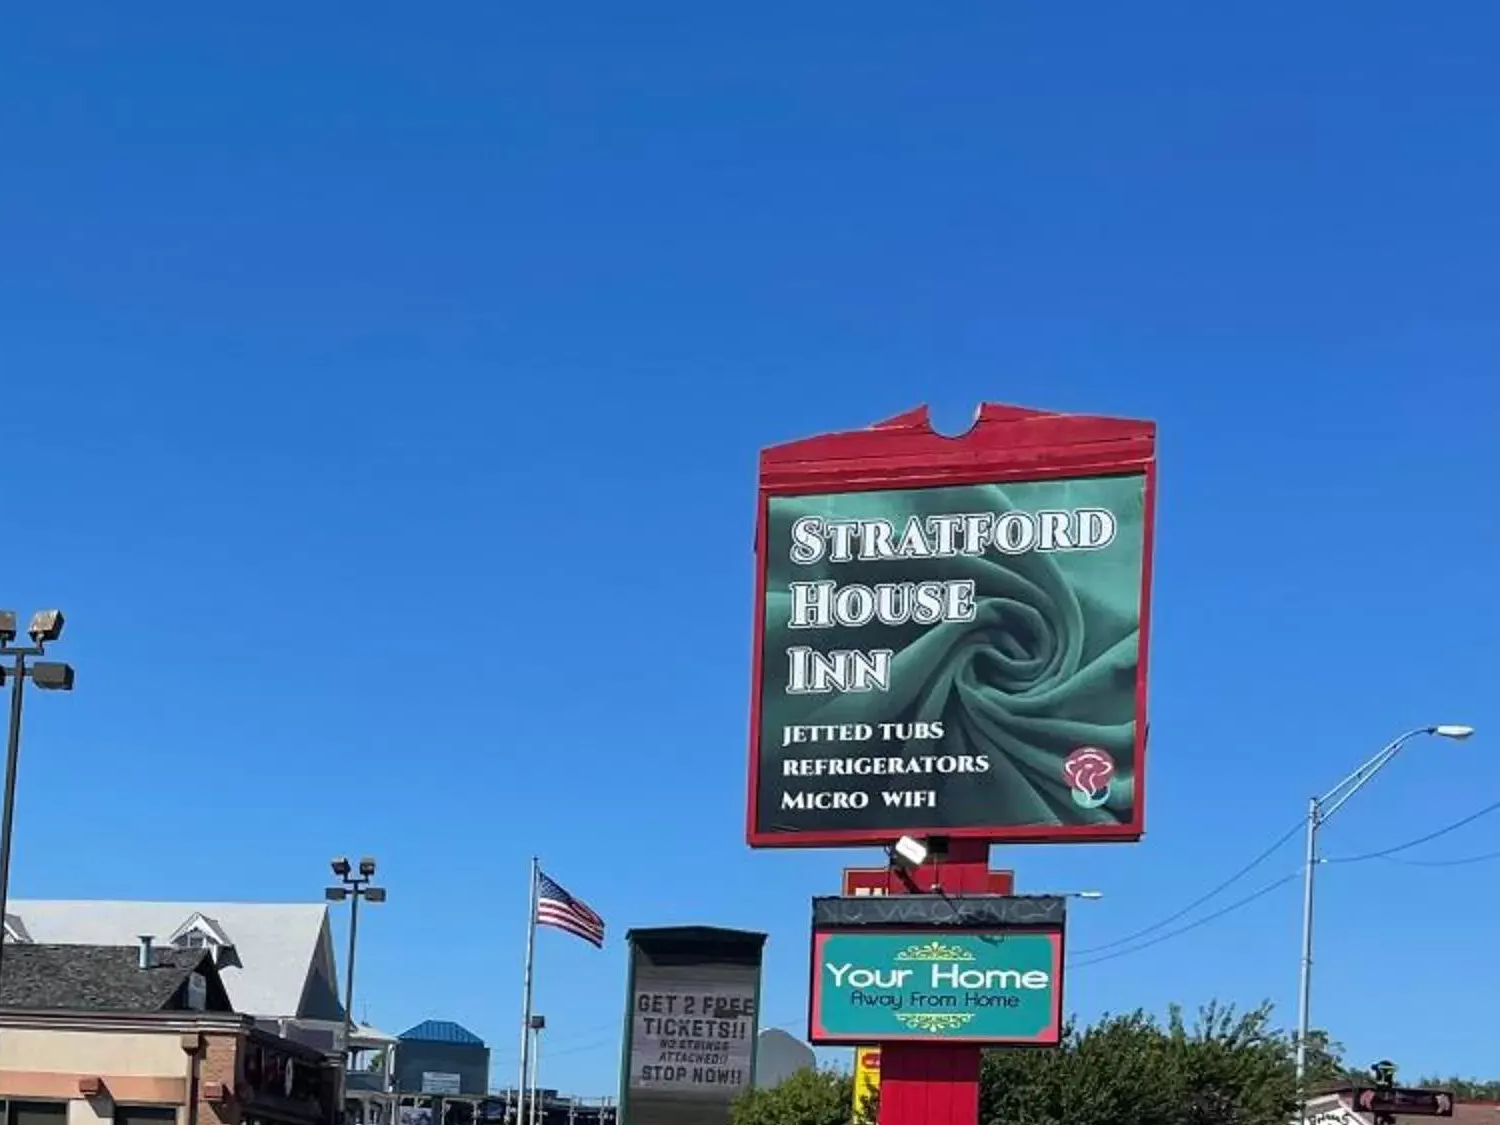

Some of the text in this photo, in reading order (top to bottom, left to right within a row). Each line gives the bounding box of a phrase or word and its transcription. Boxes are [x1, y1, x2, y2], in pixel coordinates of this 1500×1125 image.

[789, 508, 1116, 564] STRATFORD
[788, 580, 977, 629] HOUSE
[786, 647, 892, 694] INN
[782, 721, 944, 746] JETTED TUBS
[782, 756, 989, 776] REFRIGERATORS
[782, 790, 936, 809] MICRO WIFI
[876, 900, 1058, 925] VACANCY
[826, 963, 1049, 989] Your Home
[638, 994, 755, 1016] GET 2 FREE
[851, 991, 1020, 1010] Away From Home
[644, 1018, 746, 1039] TICKETS!!
[642, 1065, 741, 1084] STOP NOW!!
